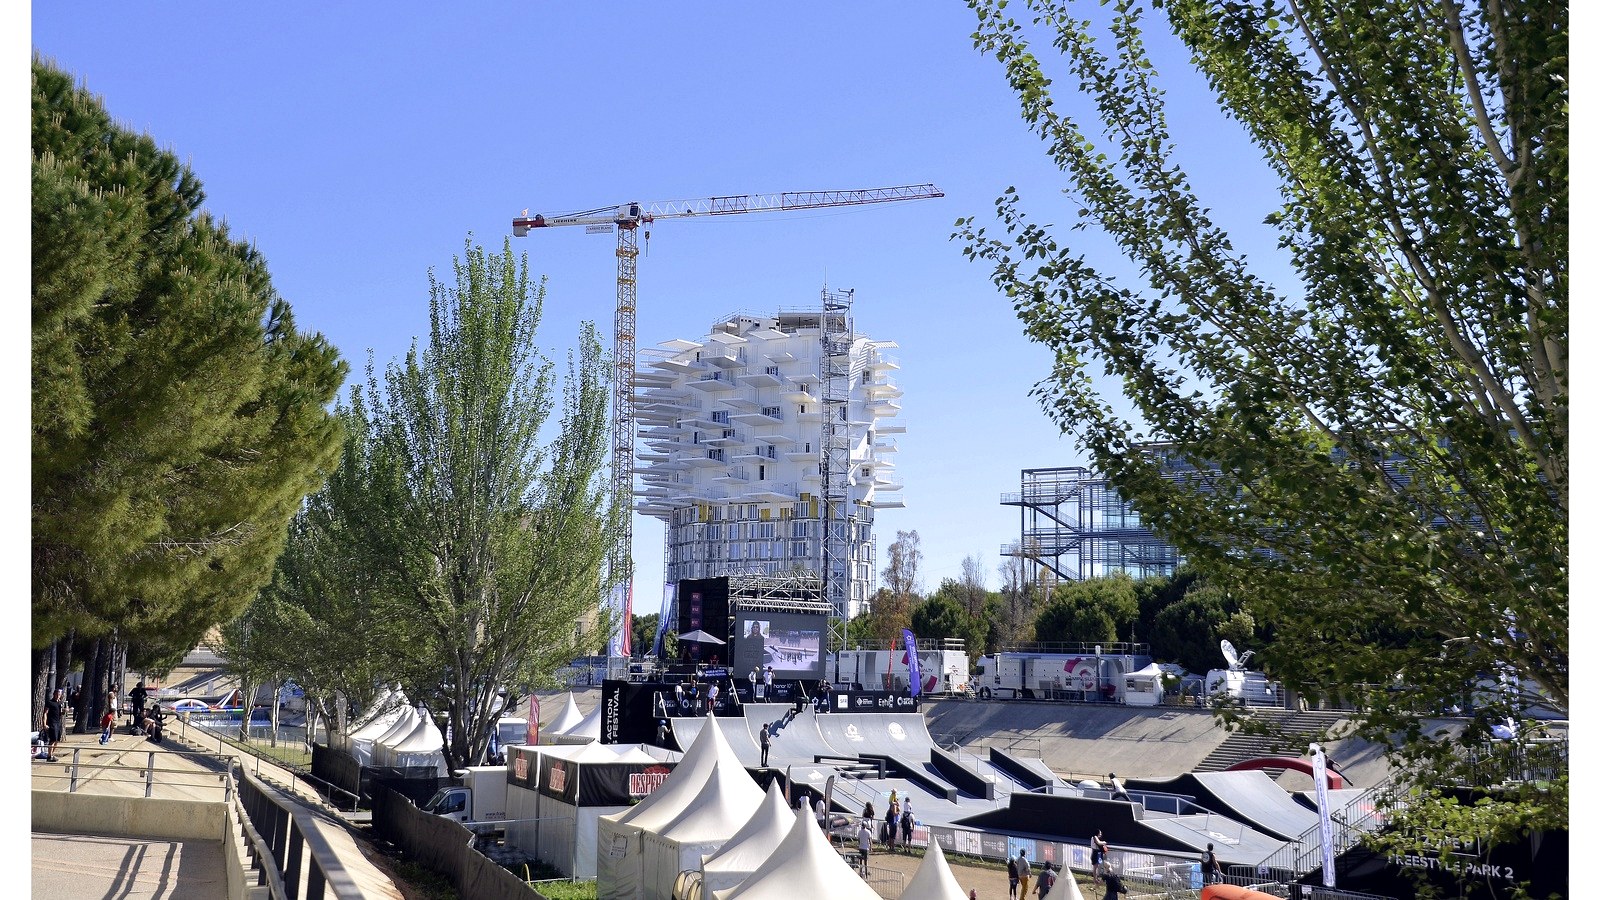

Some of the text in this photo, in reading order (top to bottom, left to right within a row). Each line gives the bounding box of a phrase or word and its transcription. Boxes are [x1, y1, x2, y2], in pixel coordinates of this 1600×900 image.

[612, 687, 620, 738] FESTIVAL
[1465, 862, 1501, 878] PARK
[1504, 867, 1514, 879] 2
